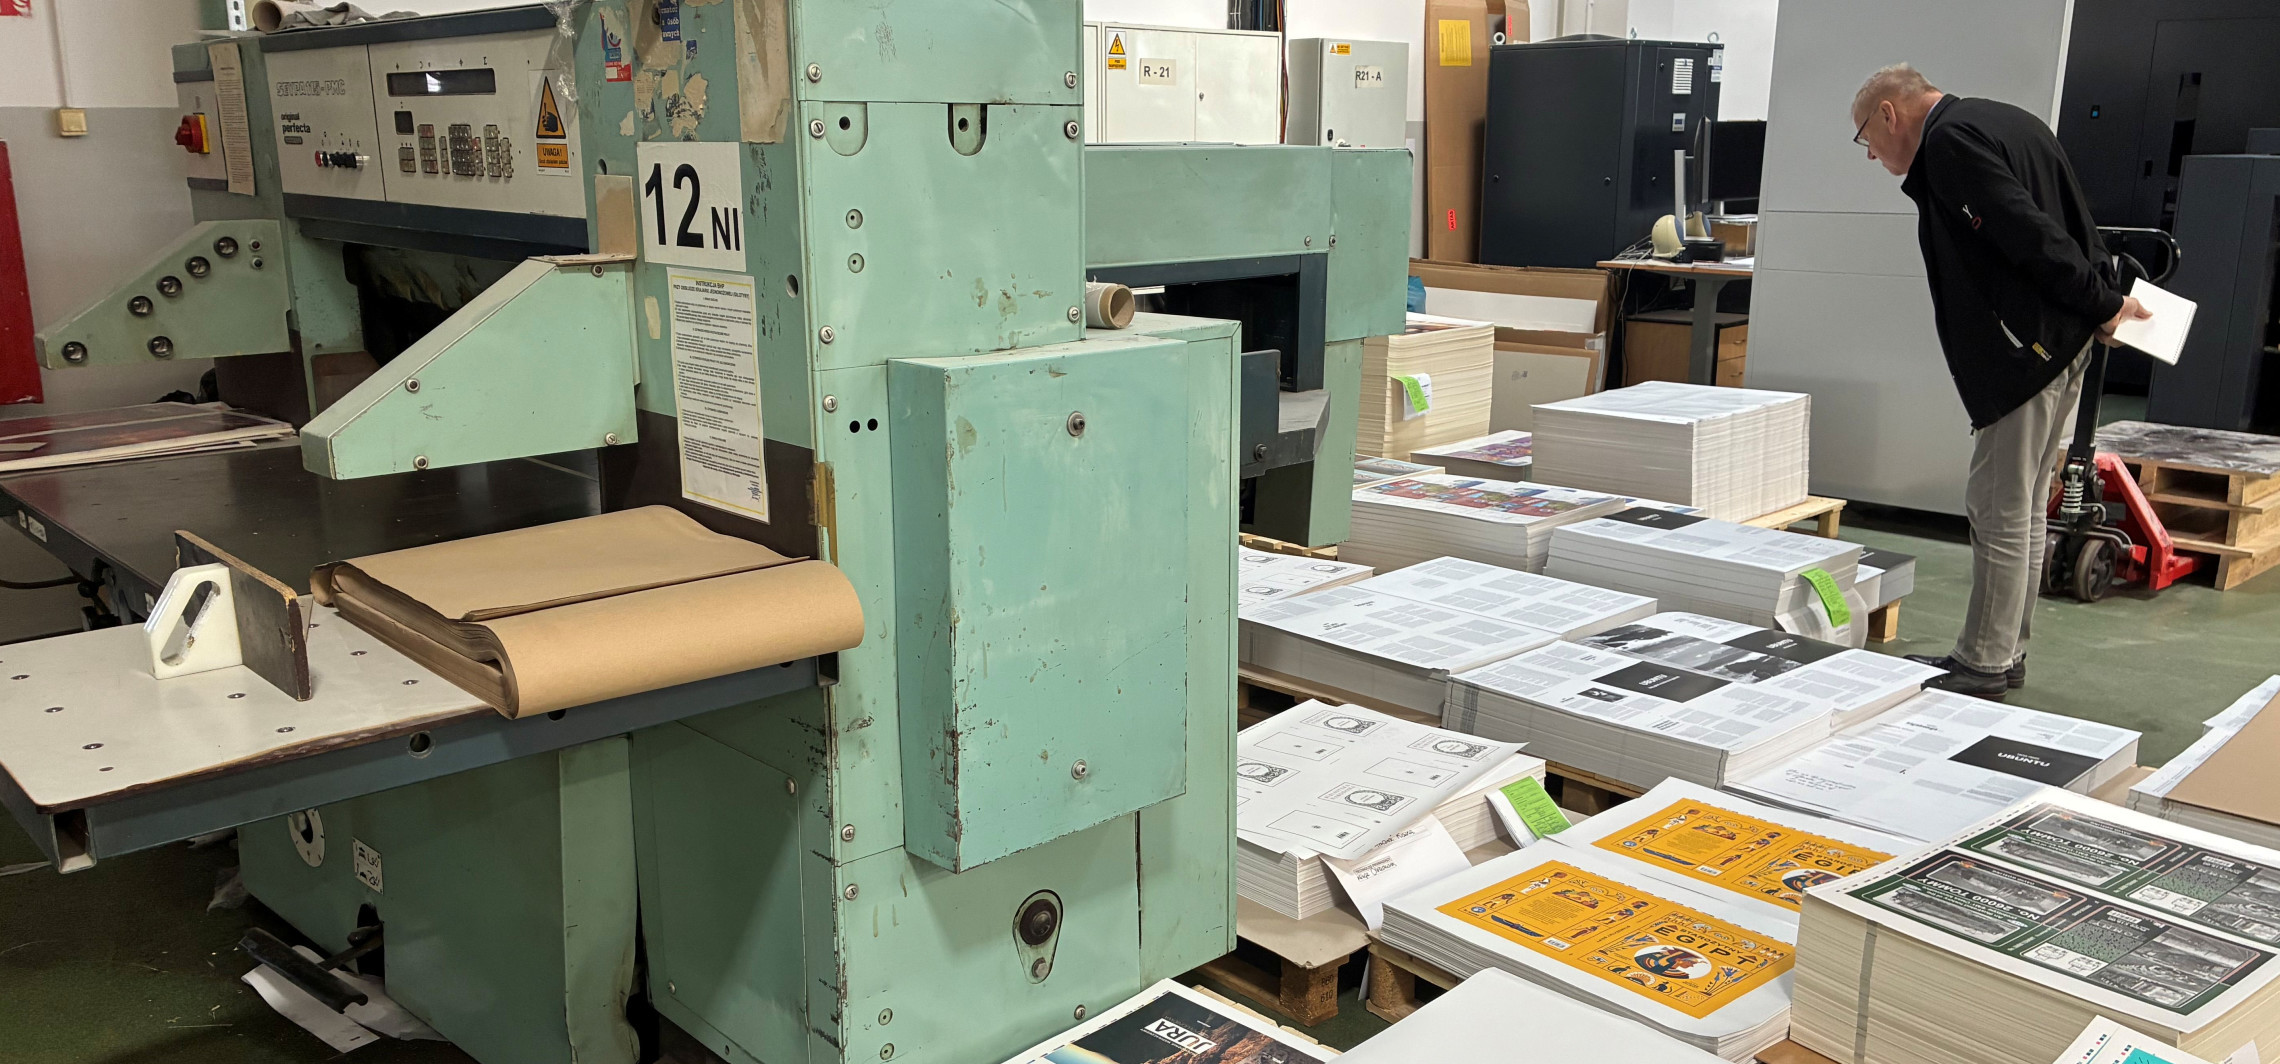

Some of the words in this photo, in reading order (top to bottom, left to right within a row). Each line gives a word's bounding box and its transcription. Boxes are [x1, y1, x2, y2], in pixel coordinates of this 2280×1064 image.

[1143, 66, 1151, 77] R
[1159, 66, 1170, 78] 21
[1355, 71, 1370, 81] R21
[1375, 72, 1382, 81] A
[281, 112, 300, 122] original
[282, 123, 311, 134] perfecta
[542, 146, 562, 157] UWAGA!
[645, 162, 704, 249] 12
[711, 207, 741, 252] NI
[1997, 752, 2051, 767] UBUNTU
[2019, 827, 2073, 845] TOMMY
[2072, 842, 2116, 858] 26000
[2113, 854, 2141, 865] No.
[1915, 876, 1971, 897] TOMMY
[1969, 893, 2014, 911] 26000
[2013, 909, 2041, 920] No.
[1654, 926, 1755, 965] EGIPT
[1153, 1021, 1212, 1051] JURA
